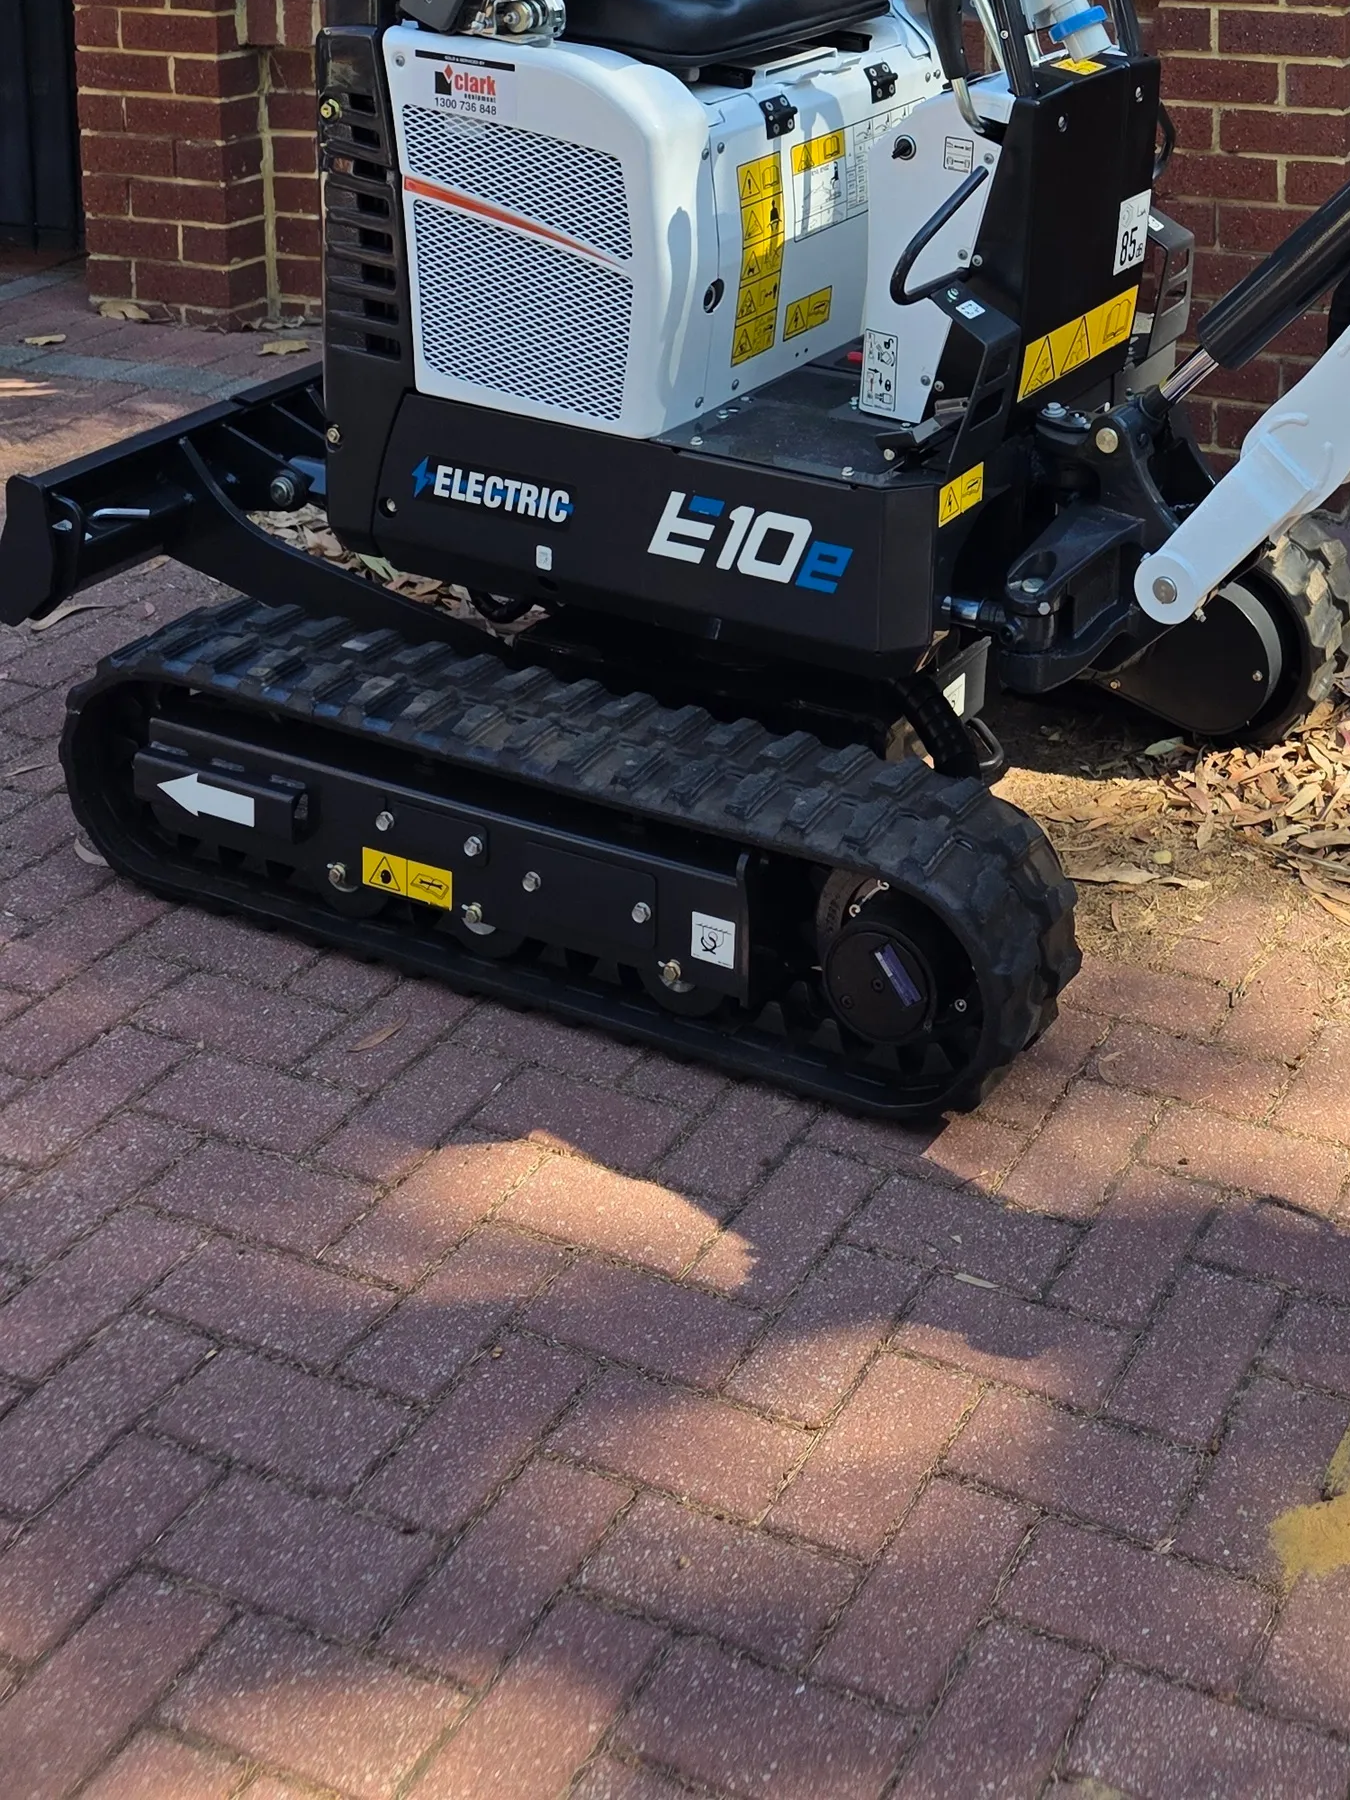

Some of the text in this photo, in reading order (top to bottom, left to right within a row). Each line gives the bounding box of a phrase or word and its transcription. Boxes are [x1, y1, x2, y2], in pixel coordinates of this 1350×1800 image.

[454, 72, 497, 96] clark
[434, 96, 497, 116] 1300 736 848
[1120, 226, 1139, 267] 85
[433, 464, 571, 523] ELECTRIC
